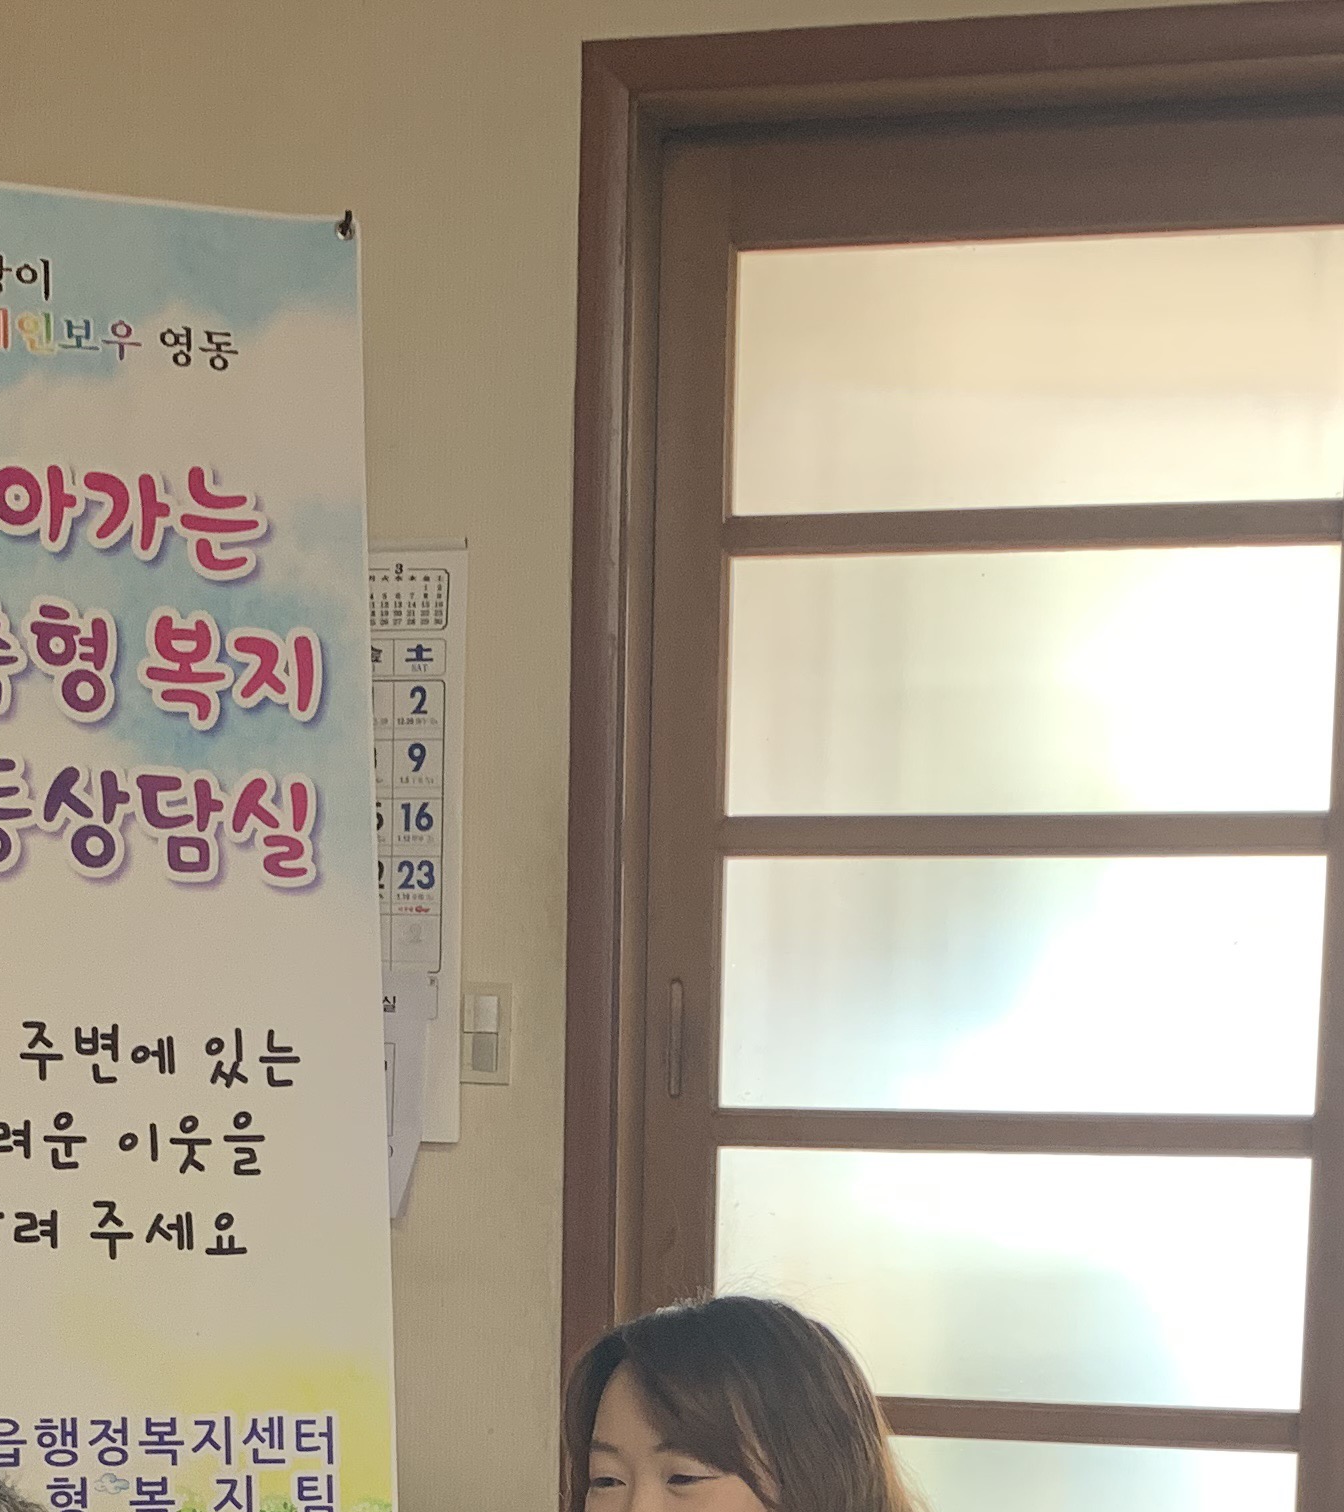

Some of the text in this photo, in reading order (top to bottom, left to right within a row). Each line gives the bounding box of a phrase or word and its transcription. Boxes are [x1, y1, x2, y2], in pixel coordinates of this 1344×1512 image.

[159, 325, 239, 371] 영동
[394, 563, 404, 575] 3
[144, 613, 316, 723] 복지
[404, 643, 434, 663] 土
[409, 685, 428, 715] 2
[407, 742, 427, 773] 9
[400, 801, 434, 832] 16
[397, 859, 435, 890] 23
[19, 1021, 177, 1084] 주변에
[204, 1028, 301, 1088] 있는
[117, 1111, 265, 1176] 이웃을
[89, 1200, 248, 1259] 주세요
